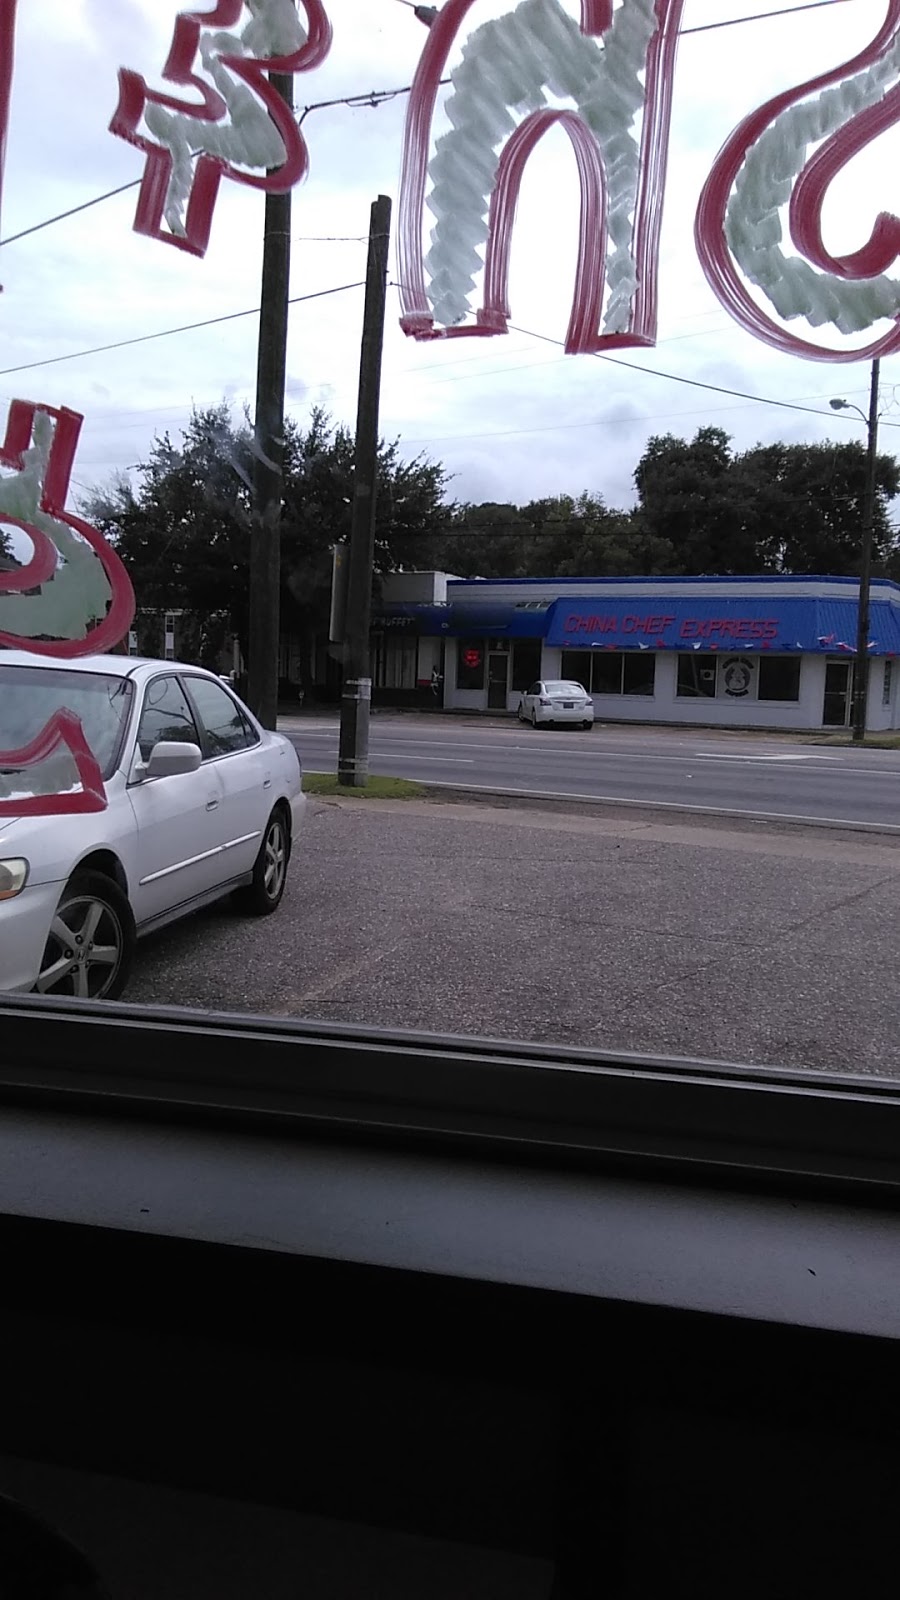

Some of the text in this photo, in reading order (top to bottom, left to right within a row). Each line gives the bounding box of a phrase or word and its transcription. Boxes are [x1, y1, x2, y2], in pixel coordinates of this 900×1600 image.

[564, 614, 778, 639] CHINA CHEF EXPRESS
